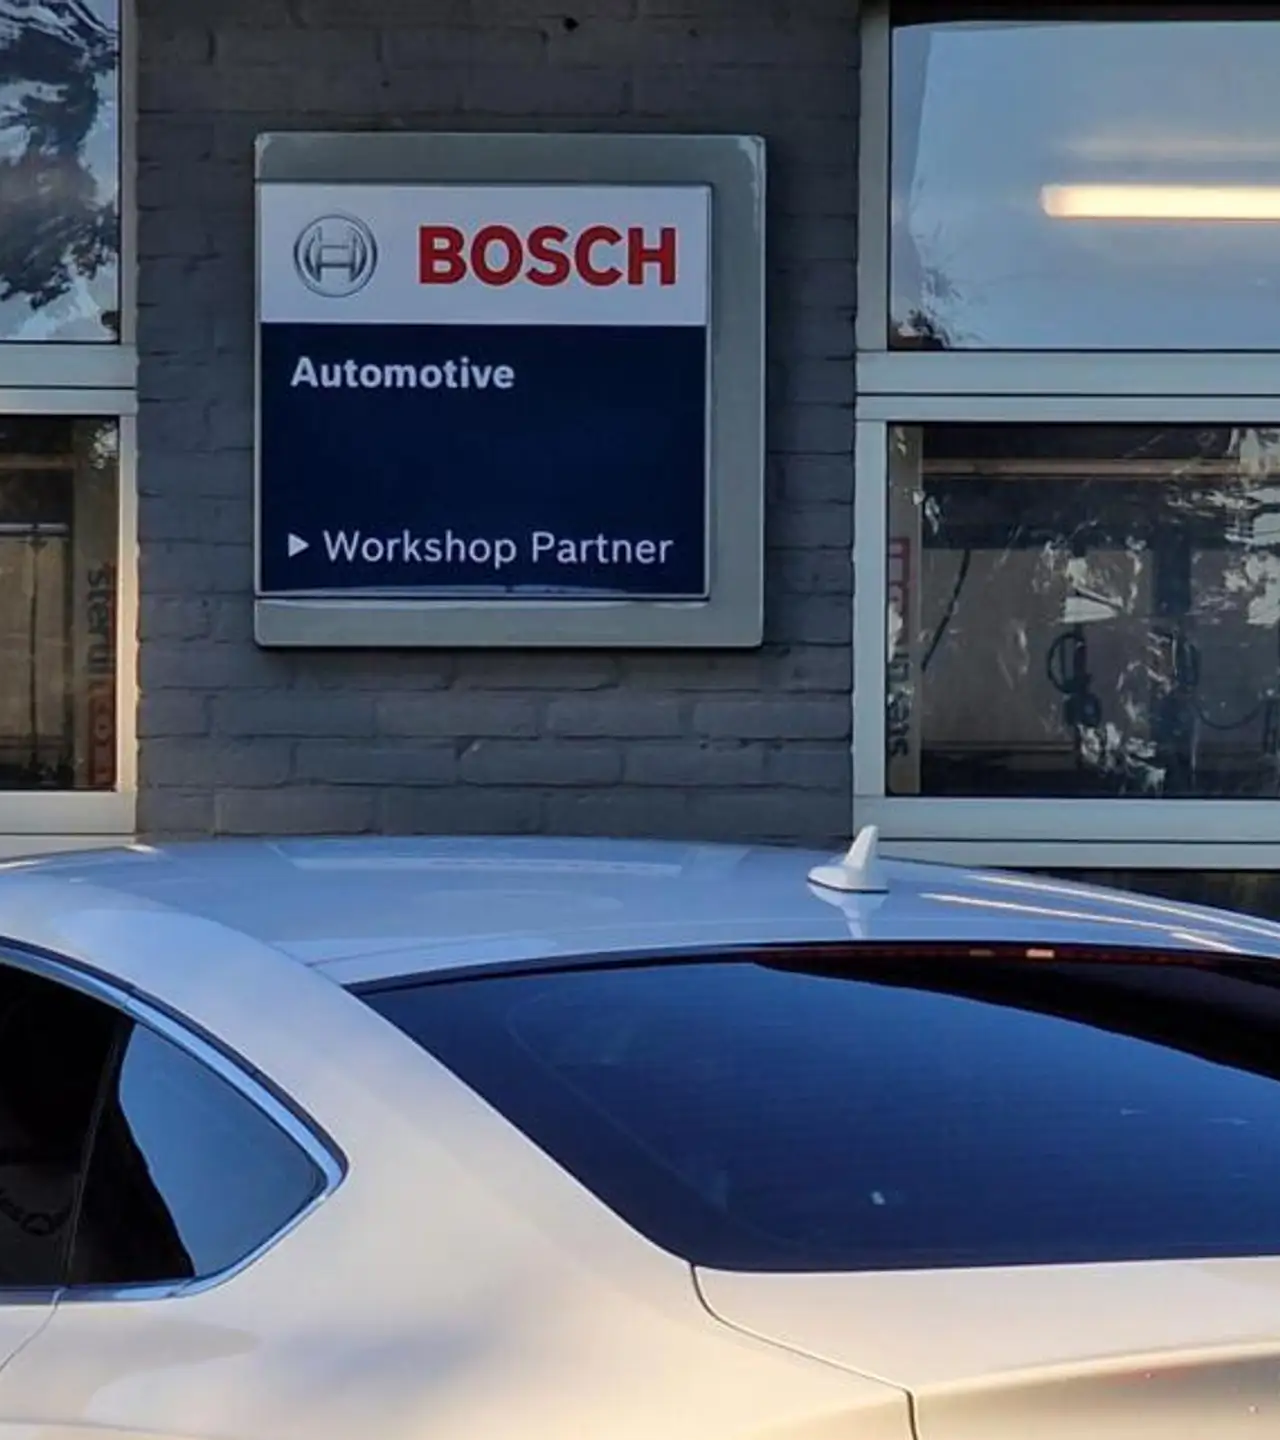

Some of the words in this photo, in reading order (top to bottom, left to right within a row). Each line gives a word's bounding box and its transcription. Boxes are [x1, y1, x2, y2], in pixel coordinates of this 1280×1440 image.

[419, 225, 677, 287] BOSCH
[290, 356, 516, 389] Automotive
[323, 530, 518, 570] Workshop
[531, 531, 674, 564] Partner
